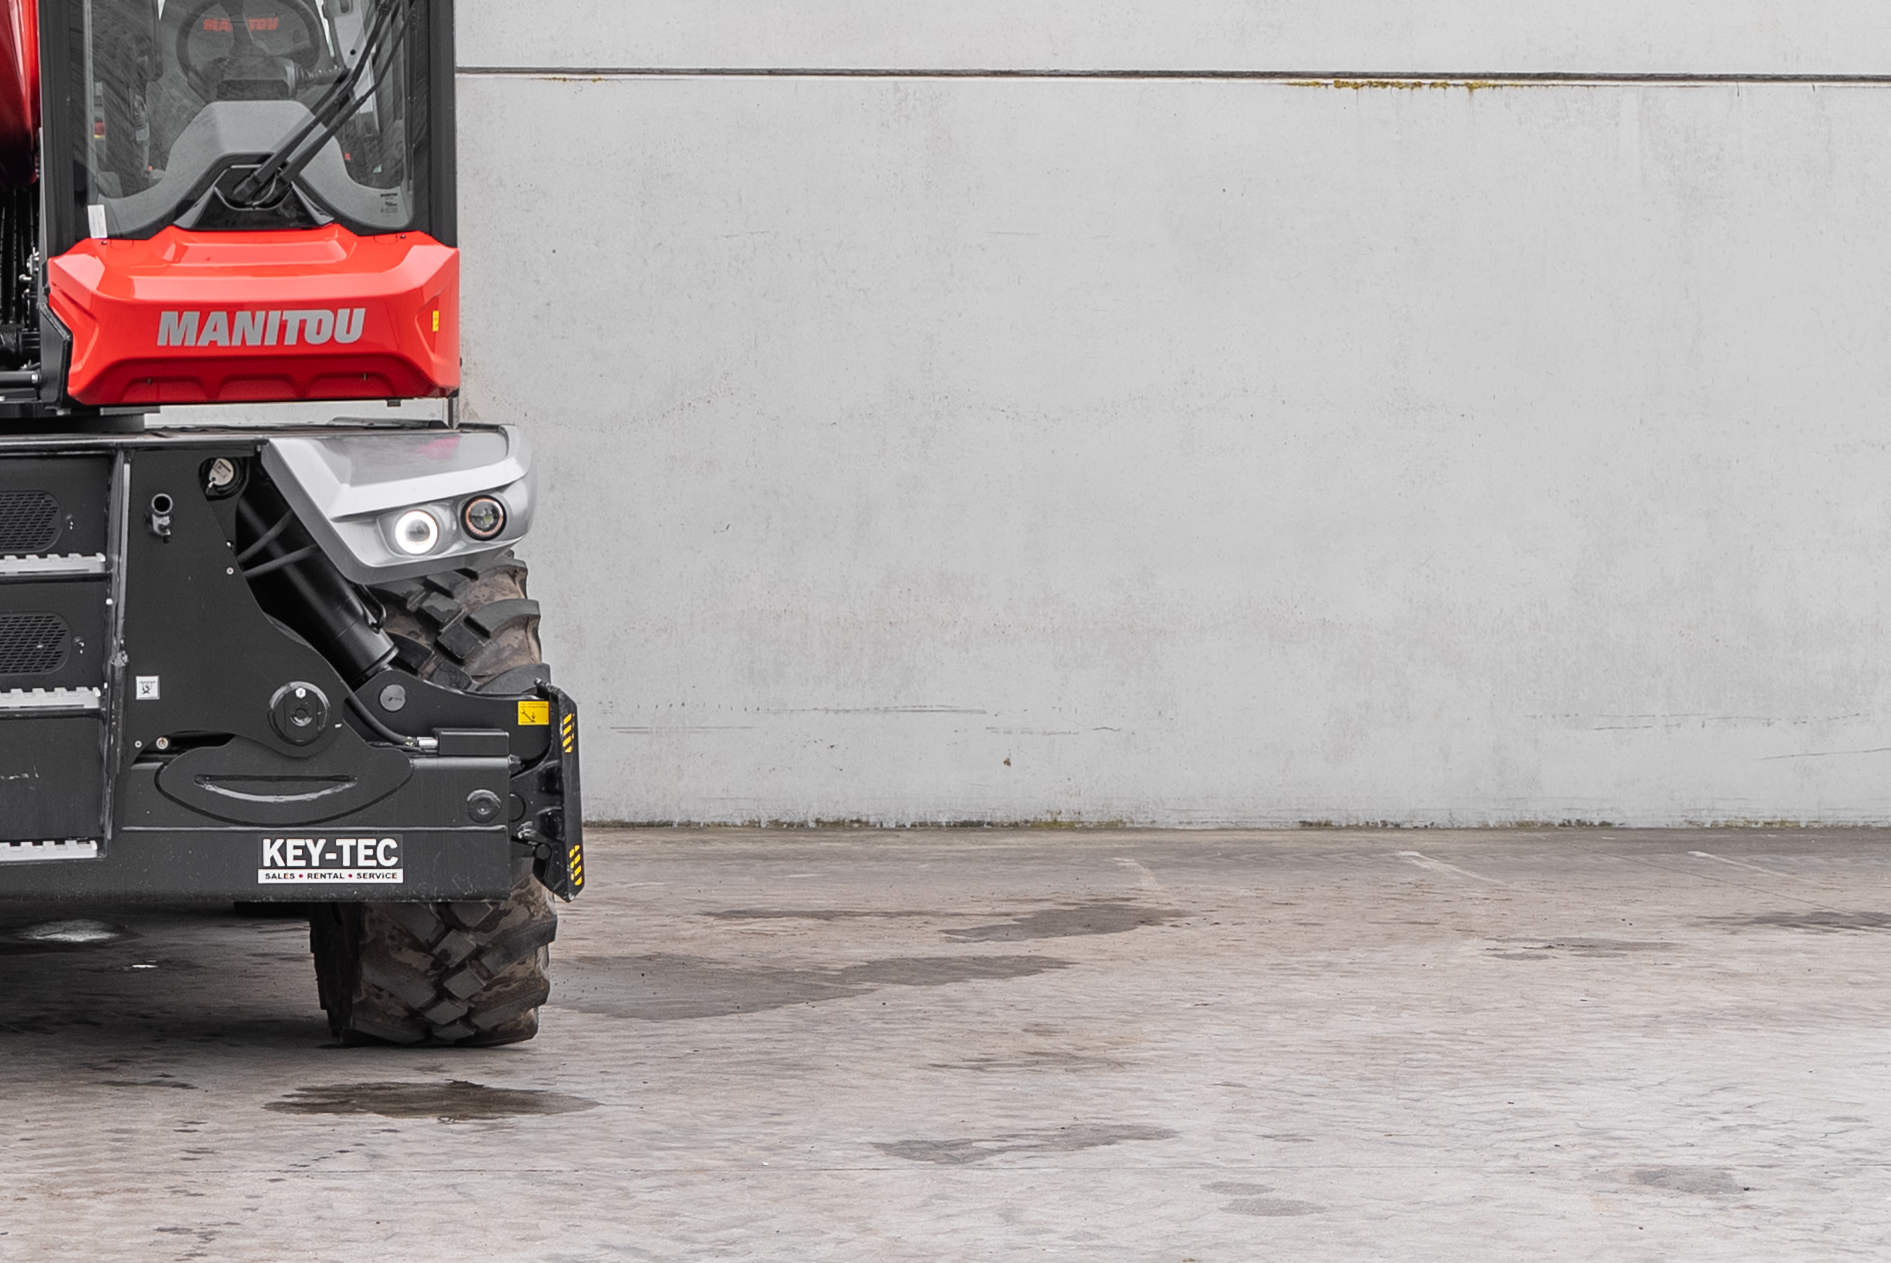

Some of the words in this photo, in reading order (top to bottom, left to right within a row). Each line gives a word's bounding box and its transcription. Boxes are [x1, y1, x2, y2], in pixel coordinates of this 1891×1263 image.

[203, 17, 278, 32] MATOU
[157, 308, 366, 346] MANITOU
[262, 838, 399, 867] KEY-TEC
[356, 872, 398, 880] SERVICE
